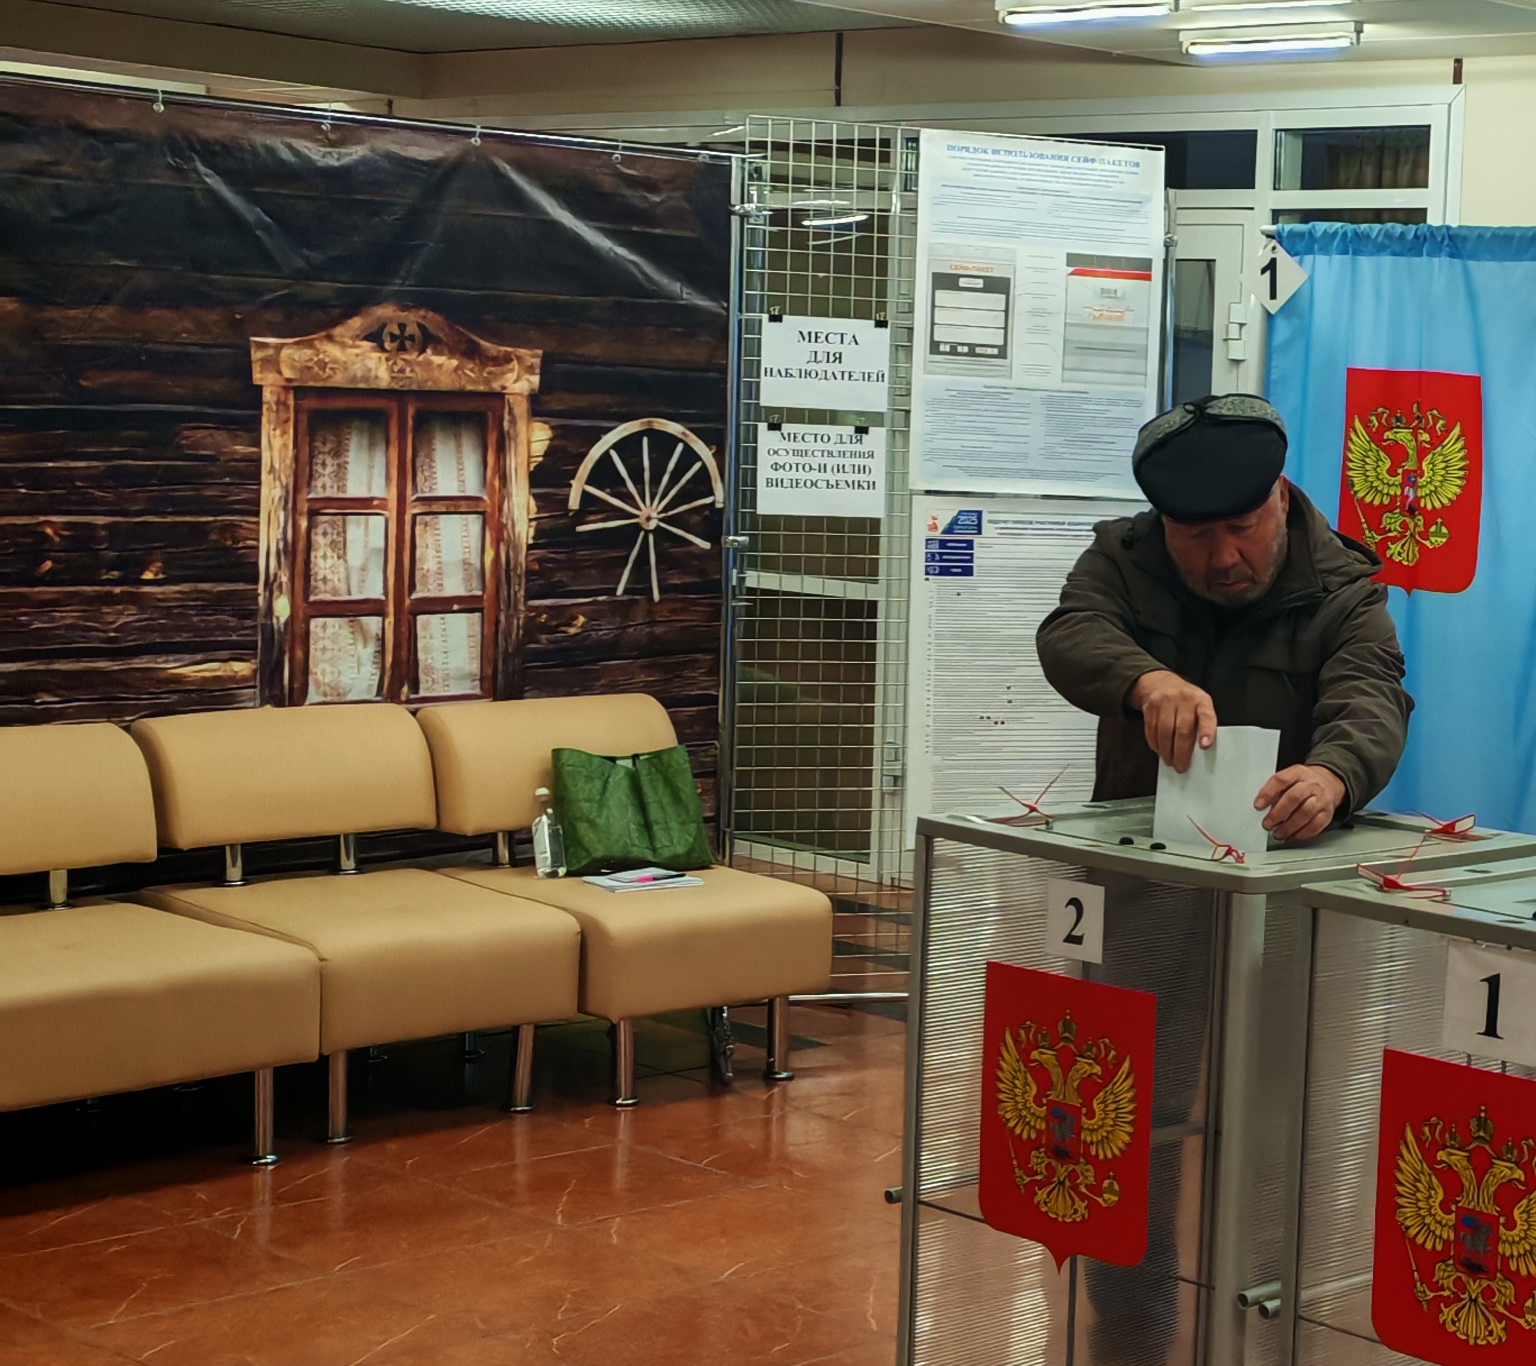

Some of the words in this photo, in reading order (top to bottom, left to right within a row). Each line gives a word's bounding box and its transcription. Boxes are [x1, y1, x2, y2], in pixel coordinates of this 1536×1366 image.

[1260, 257, 1278, 301] 1
[797, 330, 860, 346] МЕСТА
[806, 350, 843, 364] ДЛЯ
[764, 367, 886, 383] НАБЛЮДАТЕЛЕЙ
[779, 432, 831, 444] МЕСТО
[833, 434, 863, 445] ДЛЯ
[767, 448, 875, 460] ОСУЩЕСТВЛЕНИЯ
[770, 461, 828, 474] ФОТО-И
[831, 463, 872, 476] (ИЛИ)
[765, 477, 877, 491] ВИДЕОСЪЕМКИ
[1062, 897, 1085, 946] 2
[1475, 972, 1505, 1040] 1
